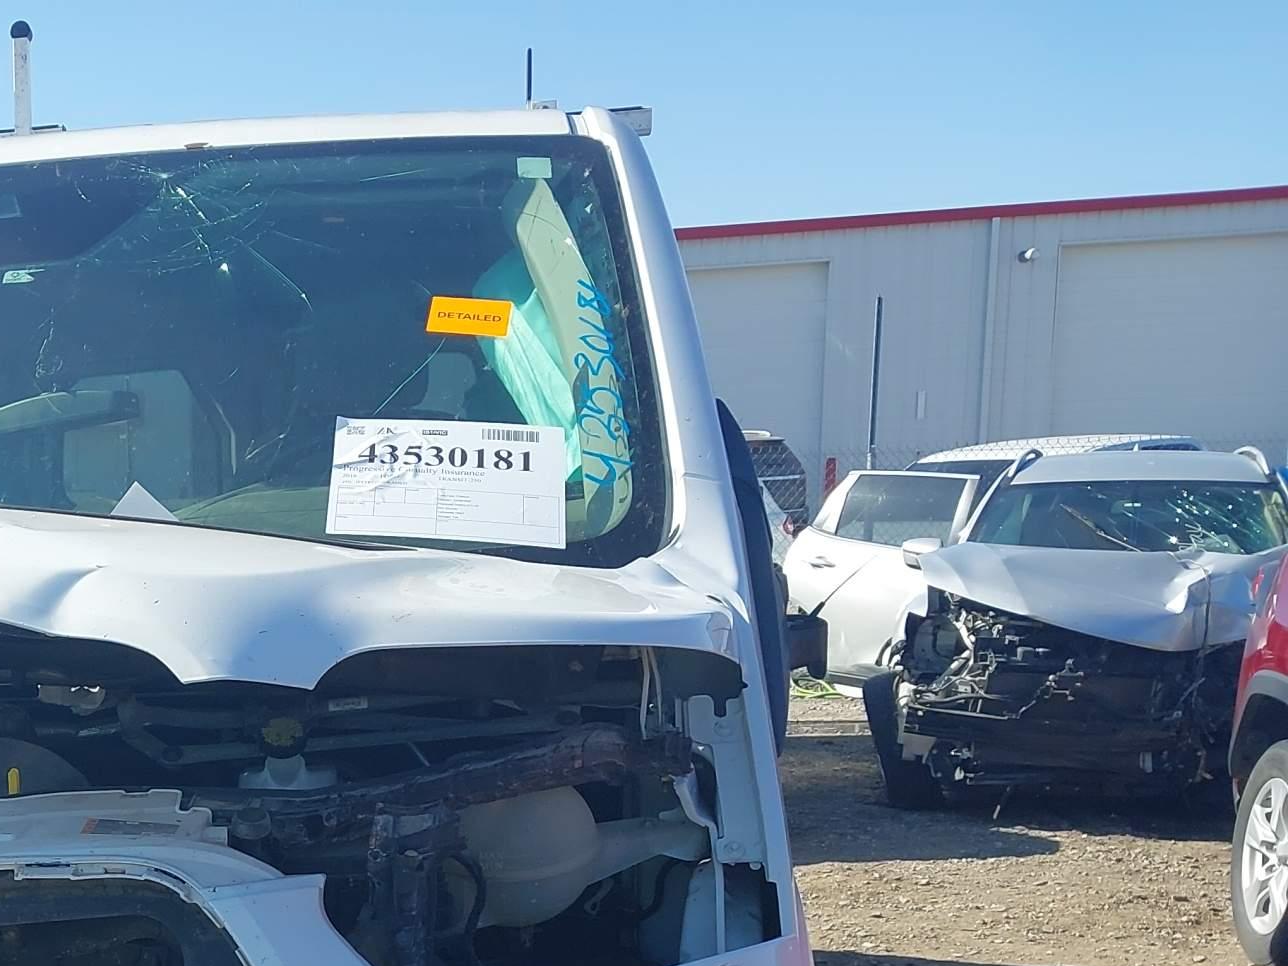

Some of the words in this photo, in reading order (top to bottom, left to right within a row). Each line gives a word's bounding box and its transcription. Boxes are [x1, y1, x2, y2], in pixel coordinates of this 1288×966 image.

[437, 311, 502, 322] DETAILED
[358, 443, 535, 472] 43530181
[442, 467, 486, 477] Insurance
